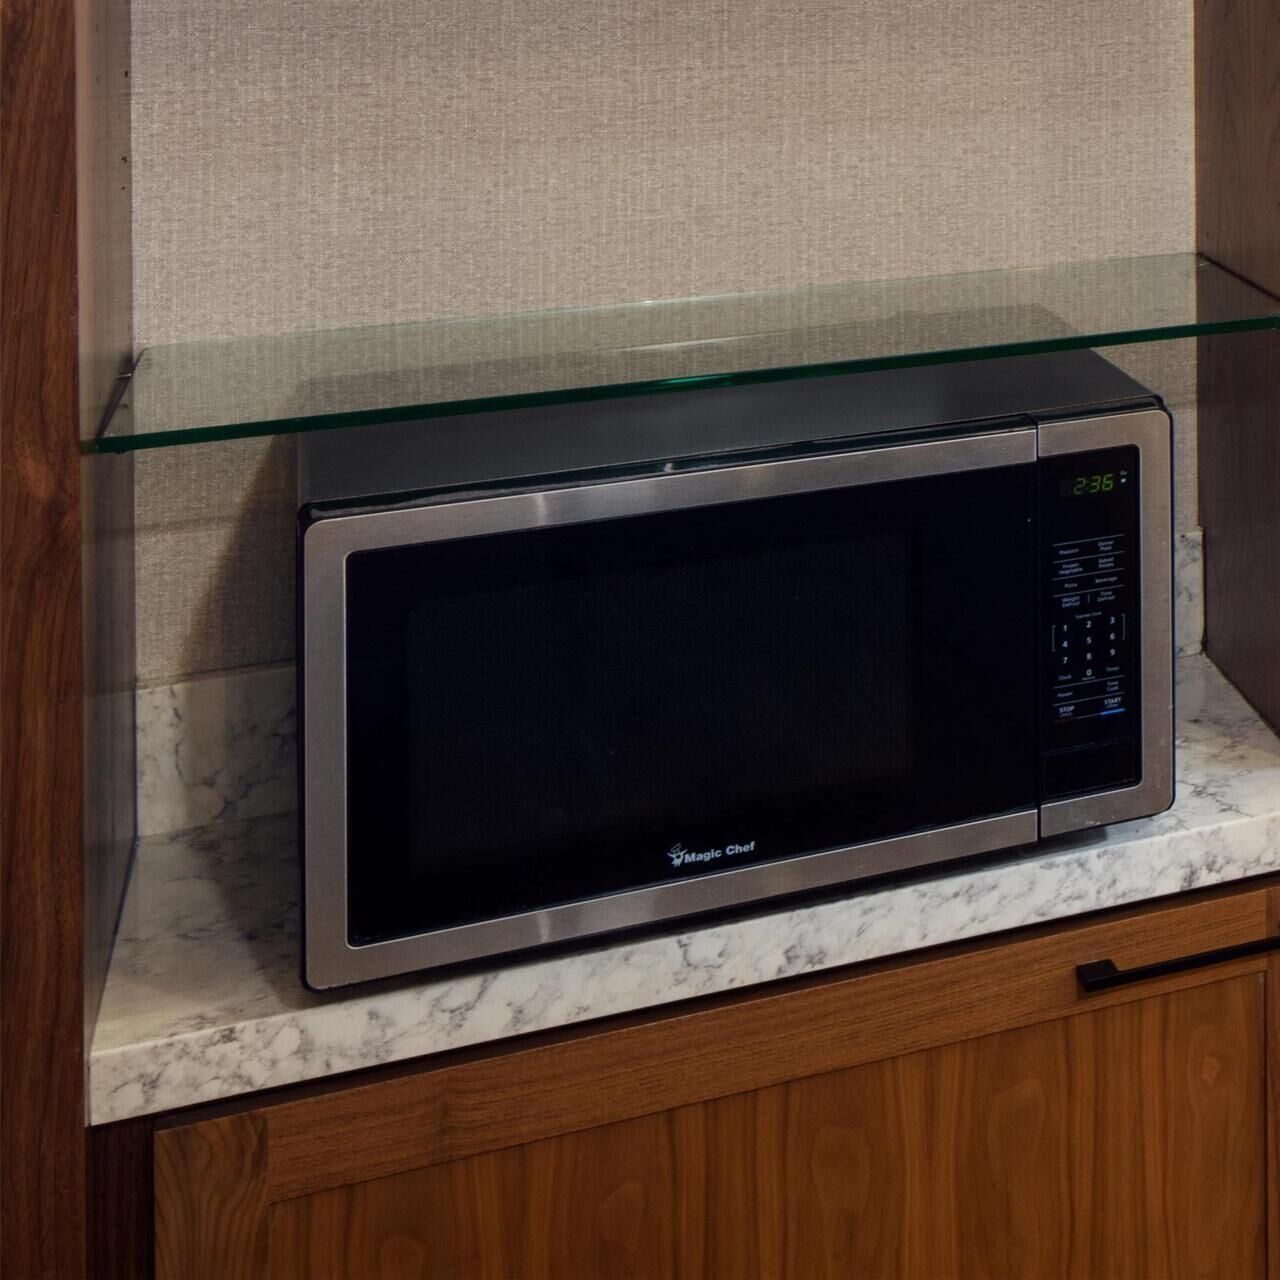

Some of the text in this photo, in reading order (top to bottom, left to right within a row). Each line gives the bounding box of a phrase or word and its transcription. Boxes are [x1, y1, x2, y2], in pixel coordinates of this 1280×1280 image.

[1073, 474, 1114, 495] 2:36
[1104, 697, 1122, 705] START
[1059, 706, 1074, 714] STOP
[684, 841, 755, 863] Magic Chef
